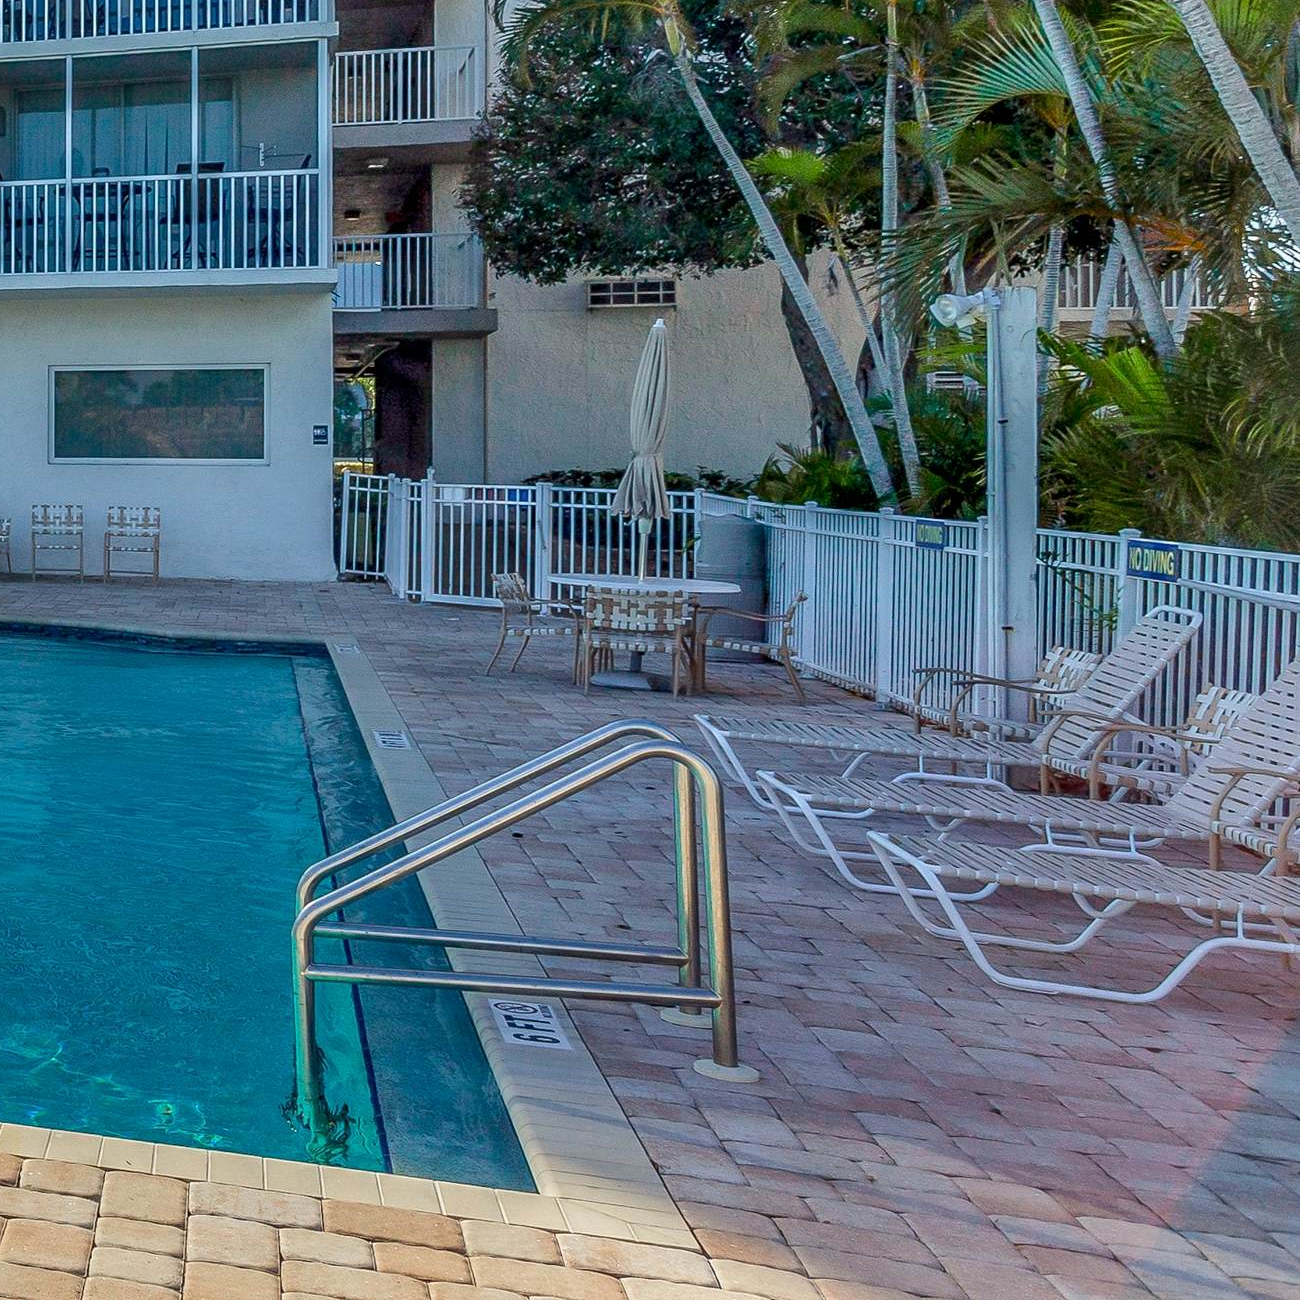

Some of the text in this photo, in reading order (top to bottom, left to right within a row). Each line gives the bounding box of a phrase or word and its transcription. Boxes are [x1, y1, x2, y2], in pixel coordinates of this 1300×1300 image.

[1128, 547, 1175, 576] NO DIVING
[503, 1014, 561, 1044] 6 FT
